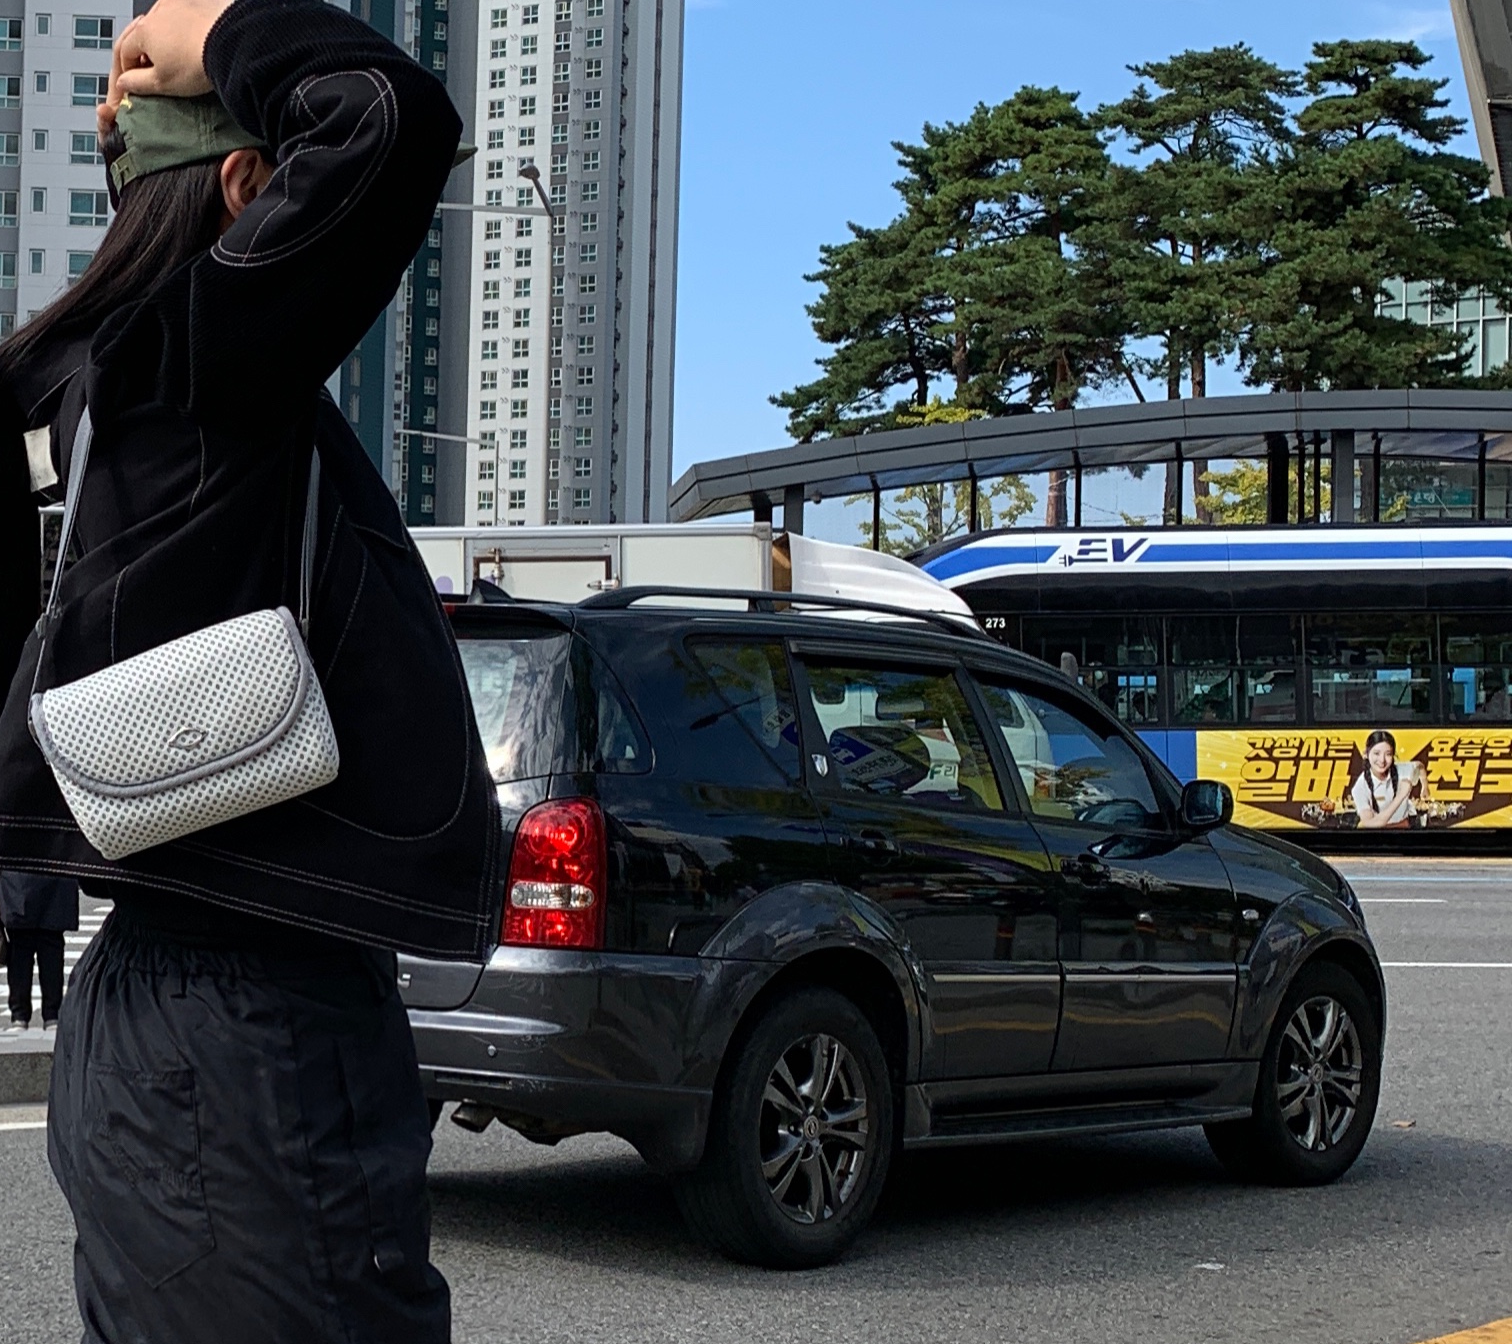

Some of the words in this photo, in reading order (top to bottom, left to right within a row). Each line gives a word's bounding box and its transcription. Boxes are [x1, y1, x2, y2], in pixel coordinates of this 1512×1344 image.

[1071, 537, 1149, 564] EV
[985, 617, 1006, 629] 273
[1246, 736, 1355, 759] 갓생사는
[1236, 758, 1351, 803] 알바
